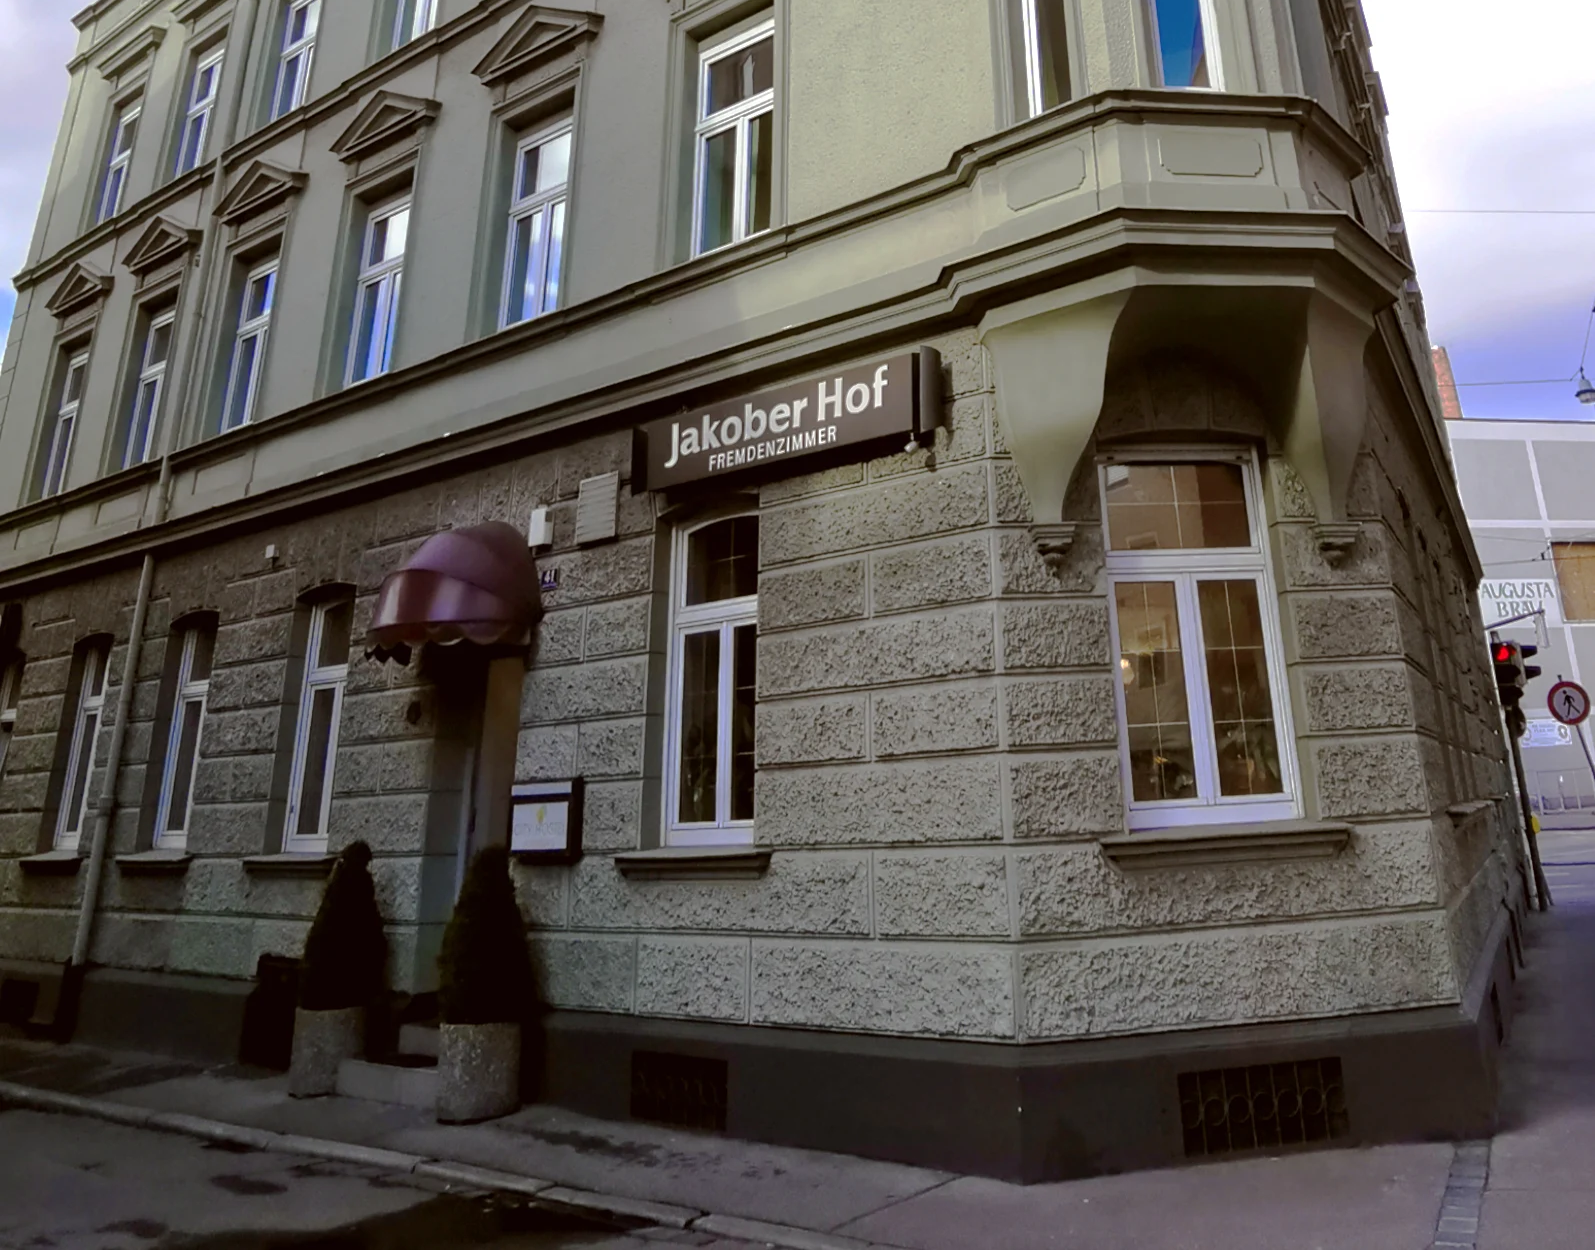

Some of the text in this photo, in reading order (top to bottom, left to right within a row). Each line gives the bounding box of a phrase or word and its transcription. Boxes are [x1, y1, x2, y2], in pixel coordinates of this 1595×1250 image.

[664, 364, 889, 468] Jakober Hof
[708, 425, 838, 472] FREMDENZIMMER
[543, 569, 556, 583] 41
[1481, 582, 1555, 599] AUGUSTA
